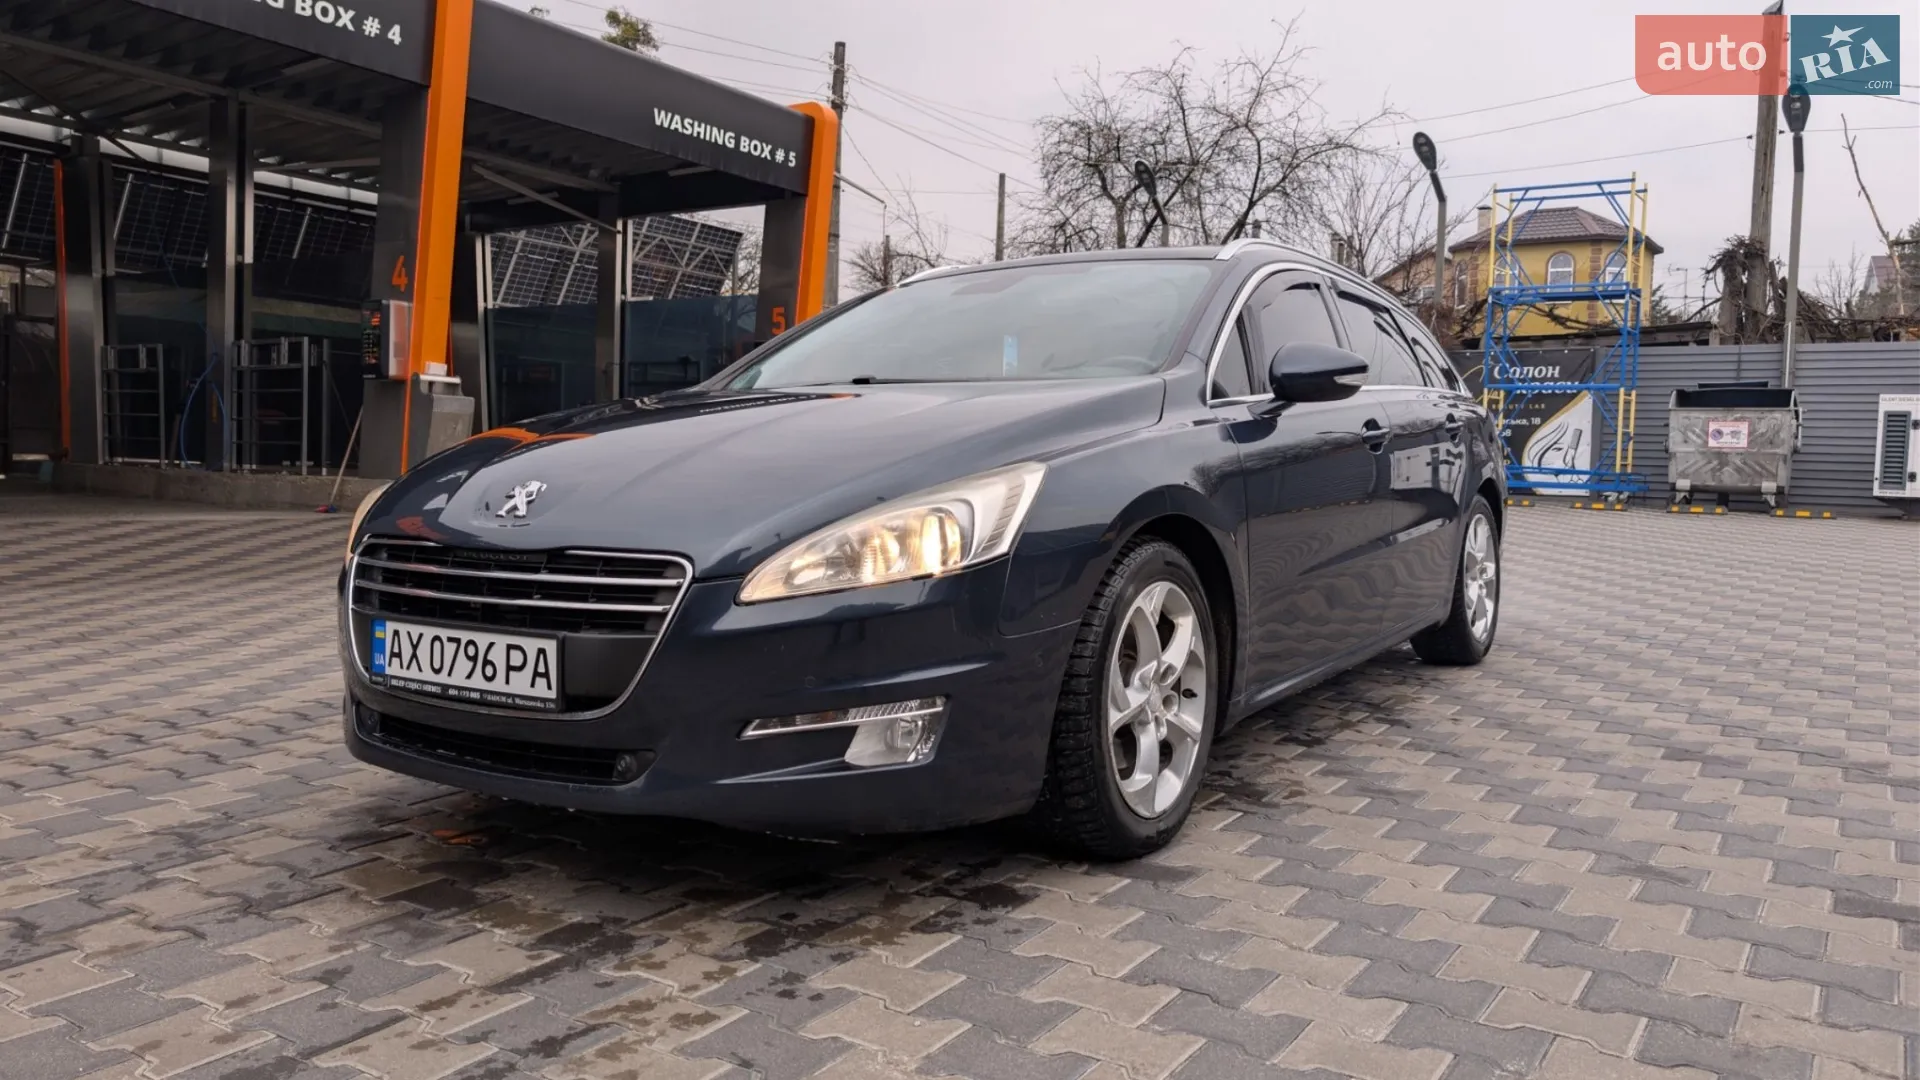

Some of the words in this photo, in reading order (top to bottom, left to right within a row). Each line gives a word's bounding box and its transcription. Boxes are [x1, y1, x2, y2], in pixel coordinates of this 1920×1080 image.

[295, 0, 356, 31] BOX
[362, 15, 381, 38] #
[387, 24, 402, 45] 4
[653, 107, 736, 149] WASHING
[739, 135, 772, 161] BOX
[775, 148, 785, 164] #
[788, 151, 797, 168] 5
[391, 255, 409, 293] 4
[771, 306, 786, 335] 5
[374, 652, 385, 666] UA
